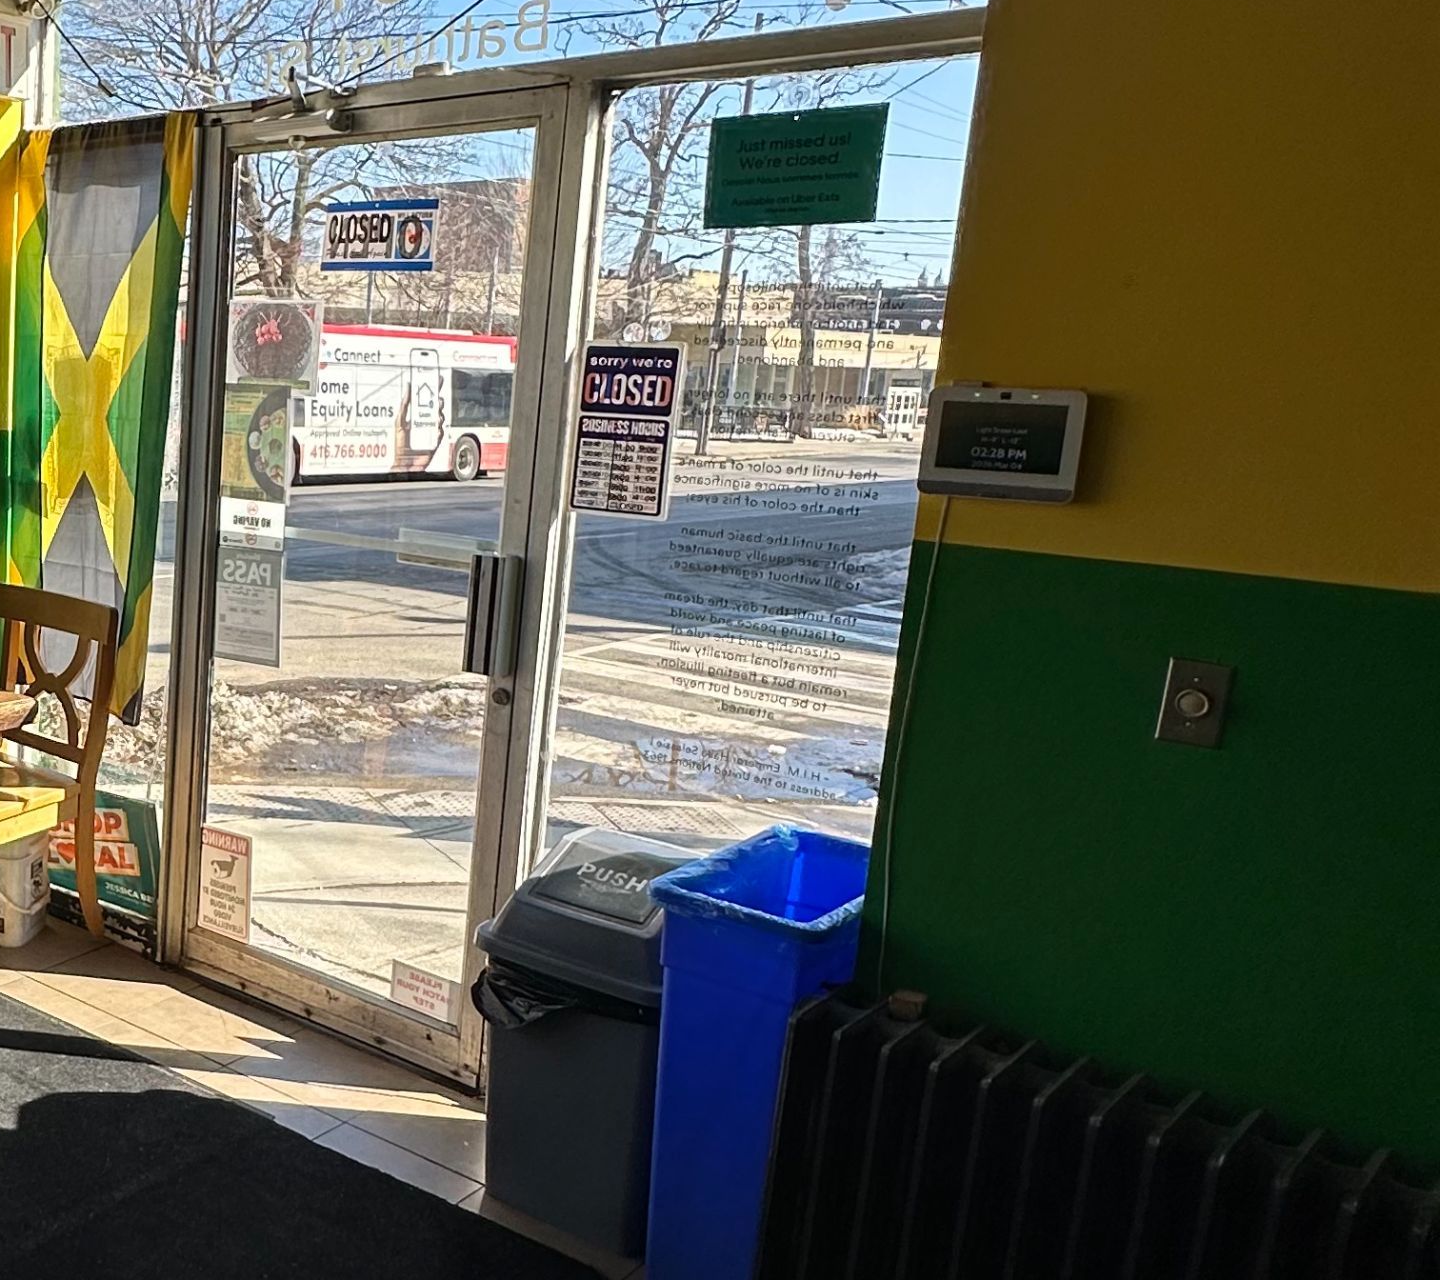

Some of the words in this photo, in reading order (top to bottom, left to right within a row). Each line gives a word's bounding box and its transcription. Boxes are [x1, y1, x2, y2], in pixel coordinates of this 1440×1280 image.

[736, 138, 766, 154] Just
[769, 134, 826, 151] missed
[739, 155, 782, 170] We're
[328, 213, 392, 244] CLOSED
[590, 357, 628, 369] sorry
[632, 357, 673, 369] we're
[584, 373, 672, 407] CLOSED
[311, 401, 353, 423] Equity
[356, 400, 394, 418] Loans
[310, 444, 387, 459] 416.766.9000
[1007, 448, 1027, 460] PM
[577, 862, 648, 892] PUSH
[105, 881, 139, 899] JESSICA
